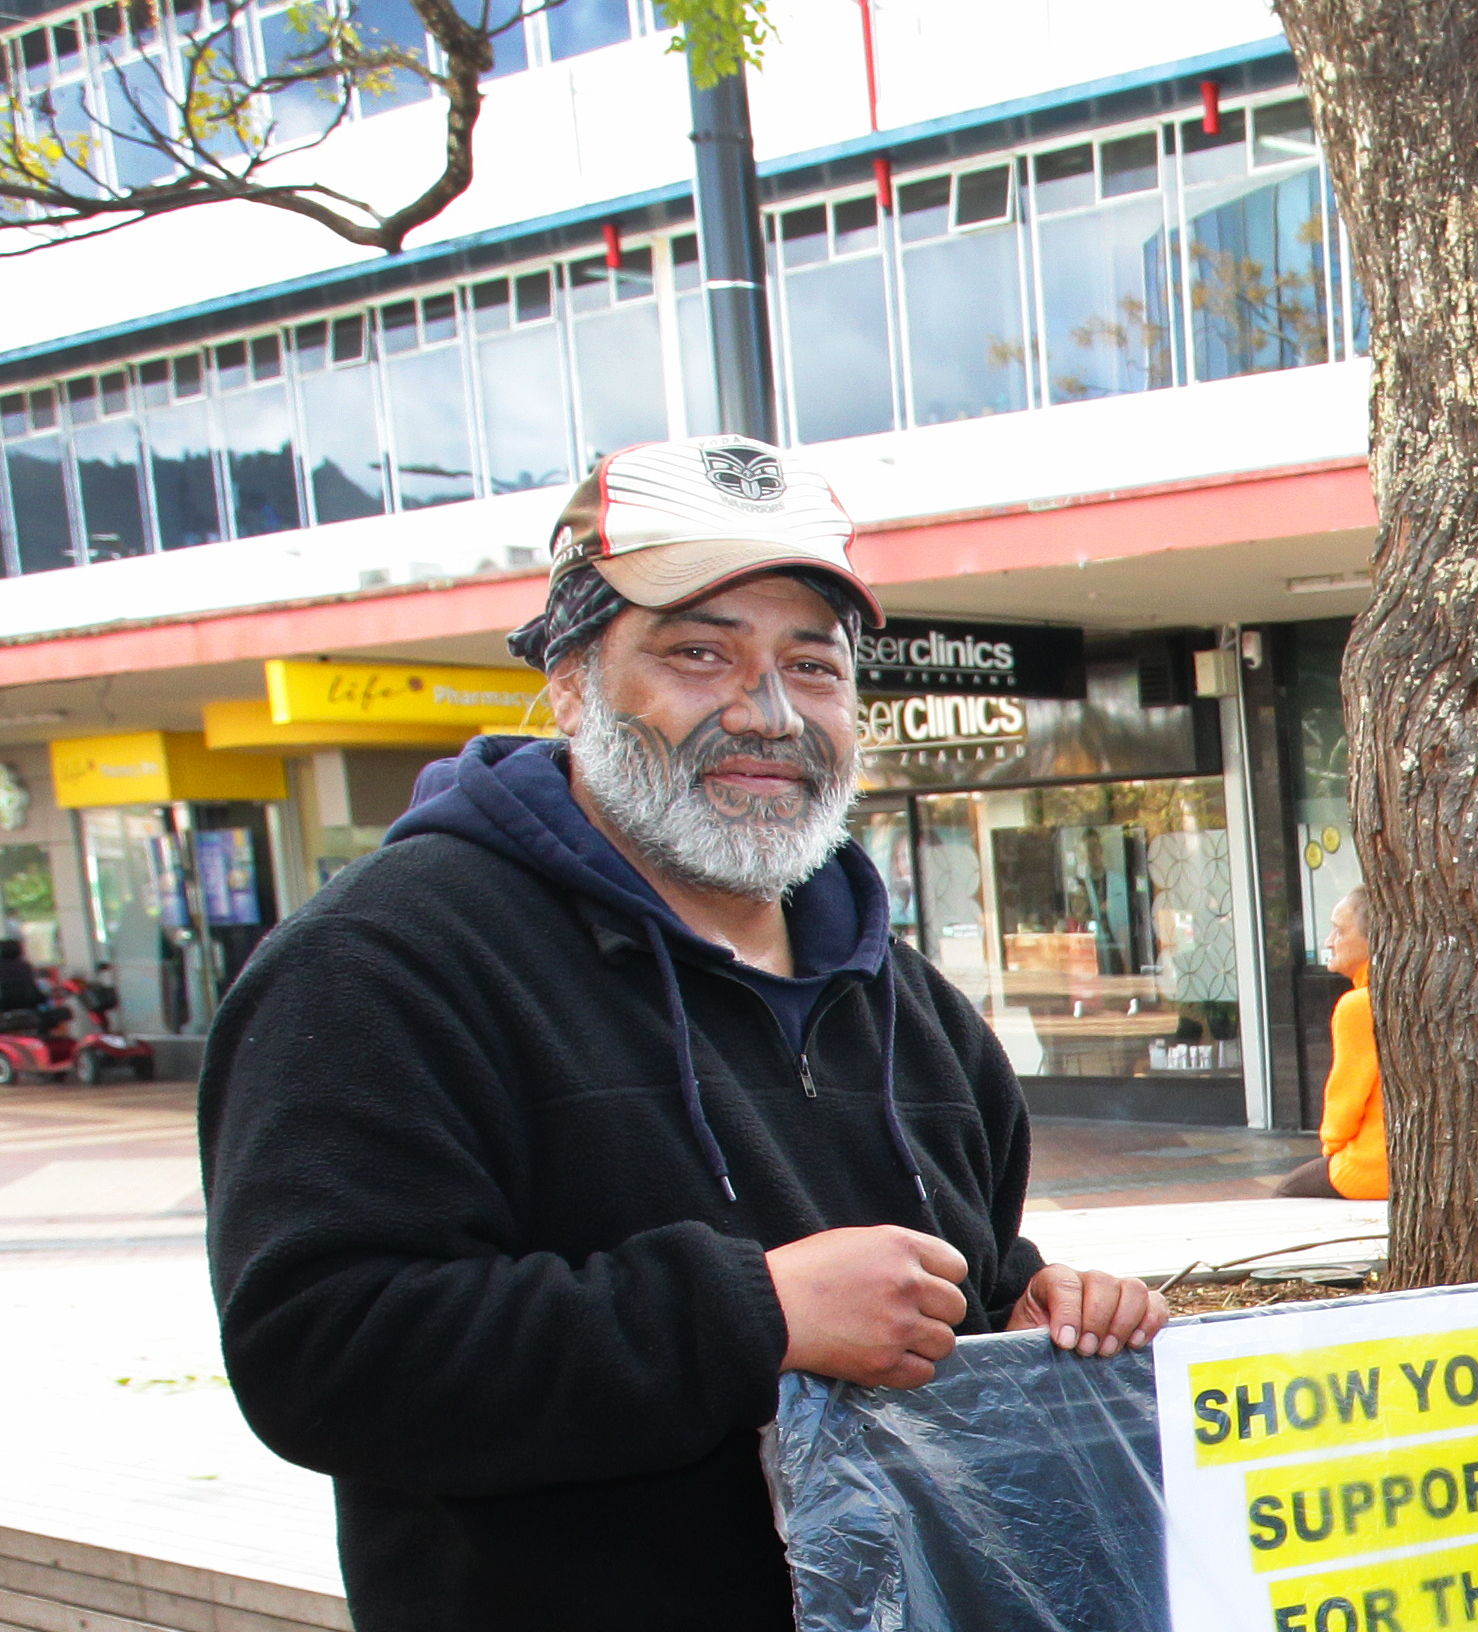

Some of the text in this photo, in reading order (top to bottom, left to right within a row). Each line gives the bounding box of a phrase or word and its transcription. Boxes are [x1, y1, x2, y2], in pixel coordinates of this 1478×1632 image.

[858, 630, 1014, 670] serclinics
[857, 694, 1025, 745] serclinics
[1195, 1367, 1379, 1446] SHOW
